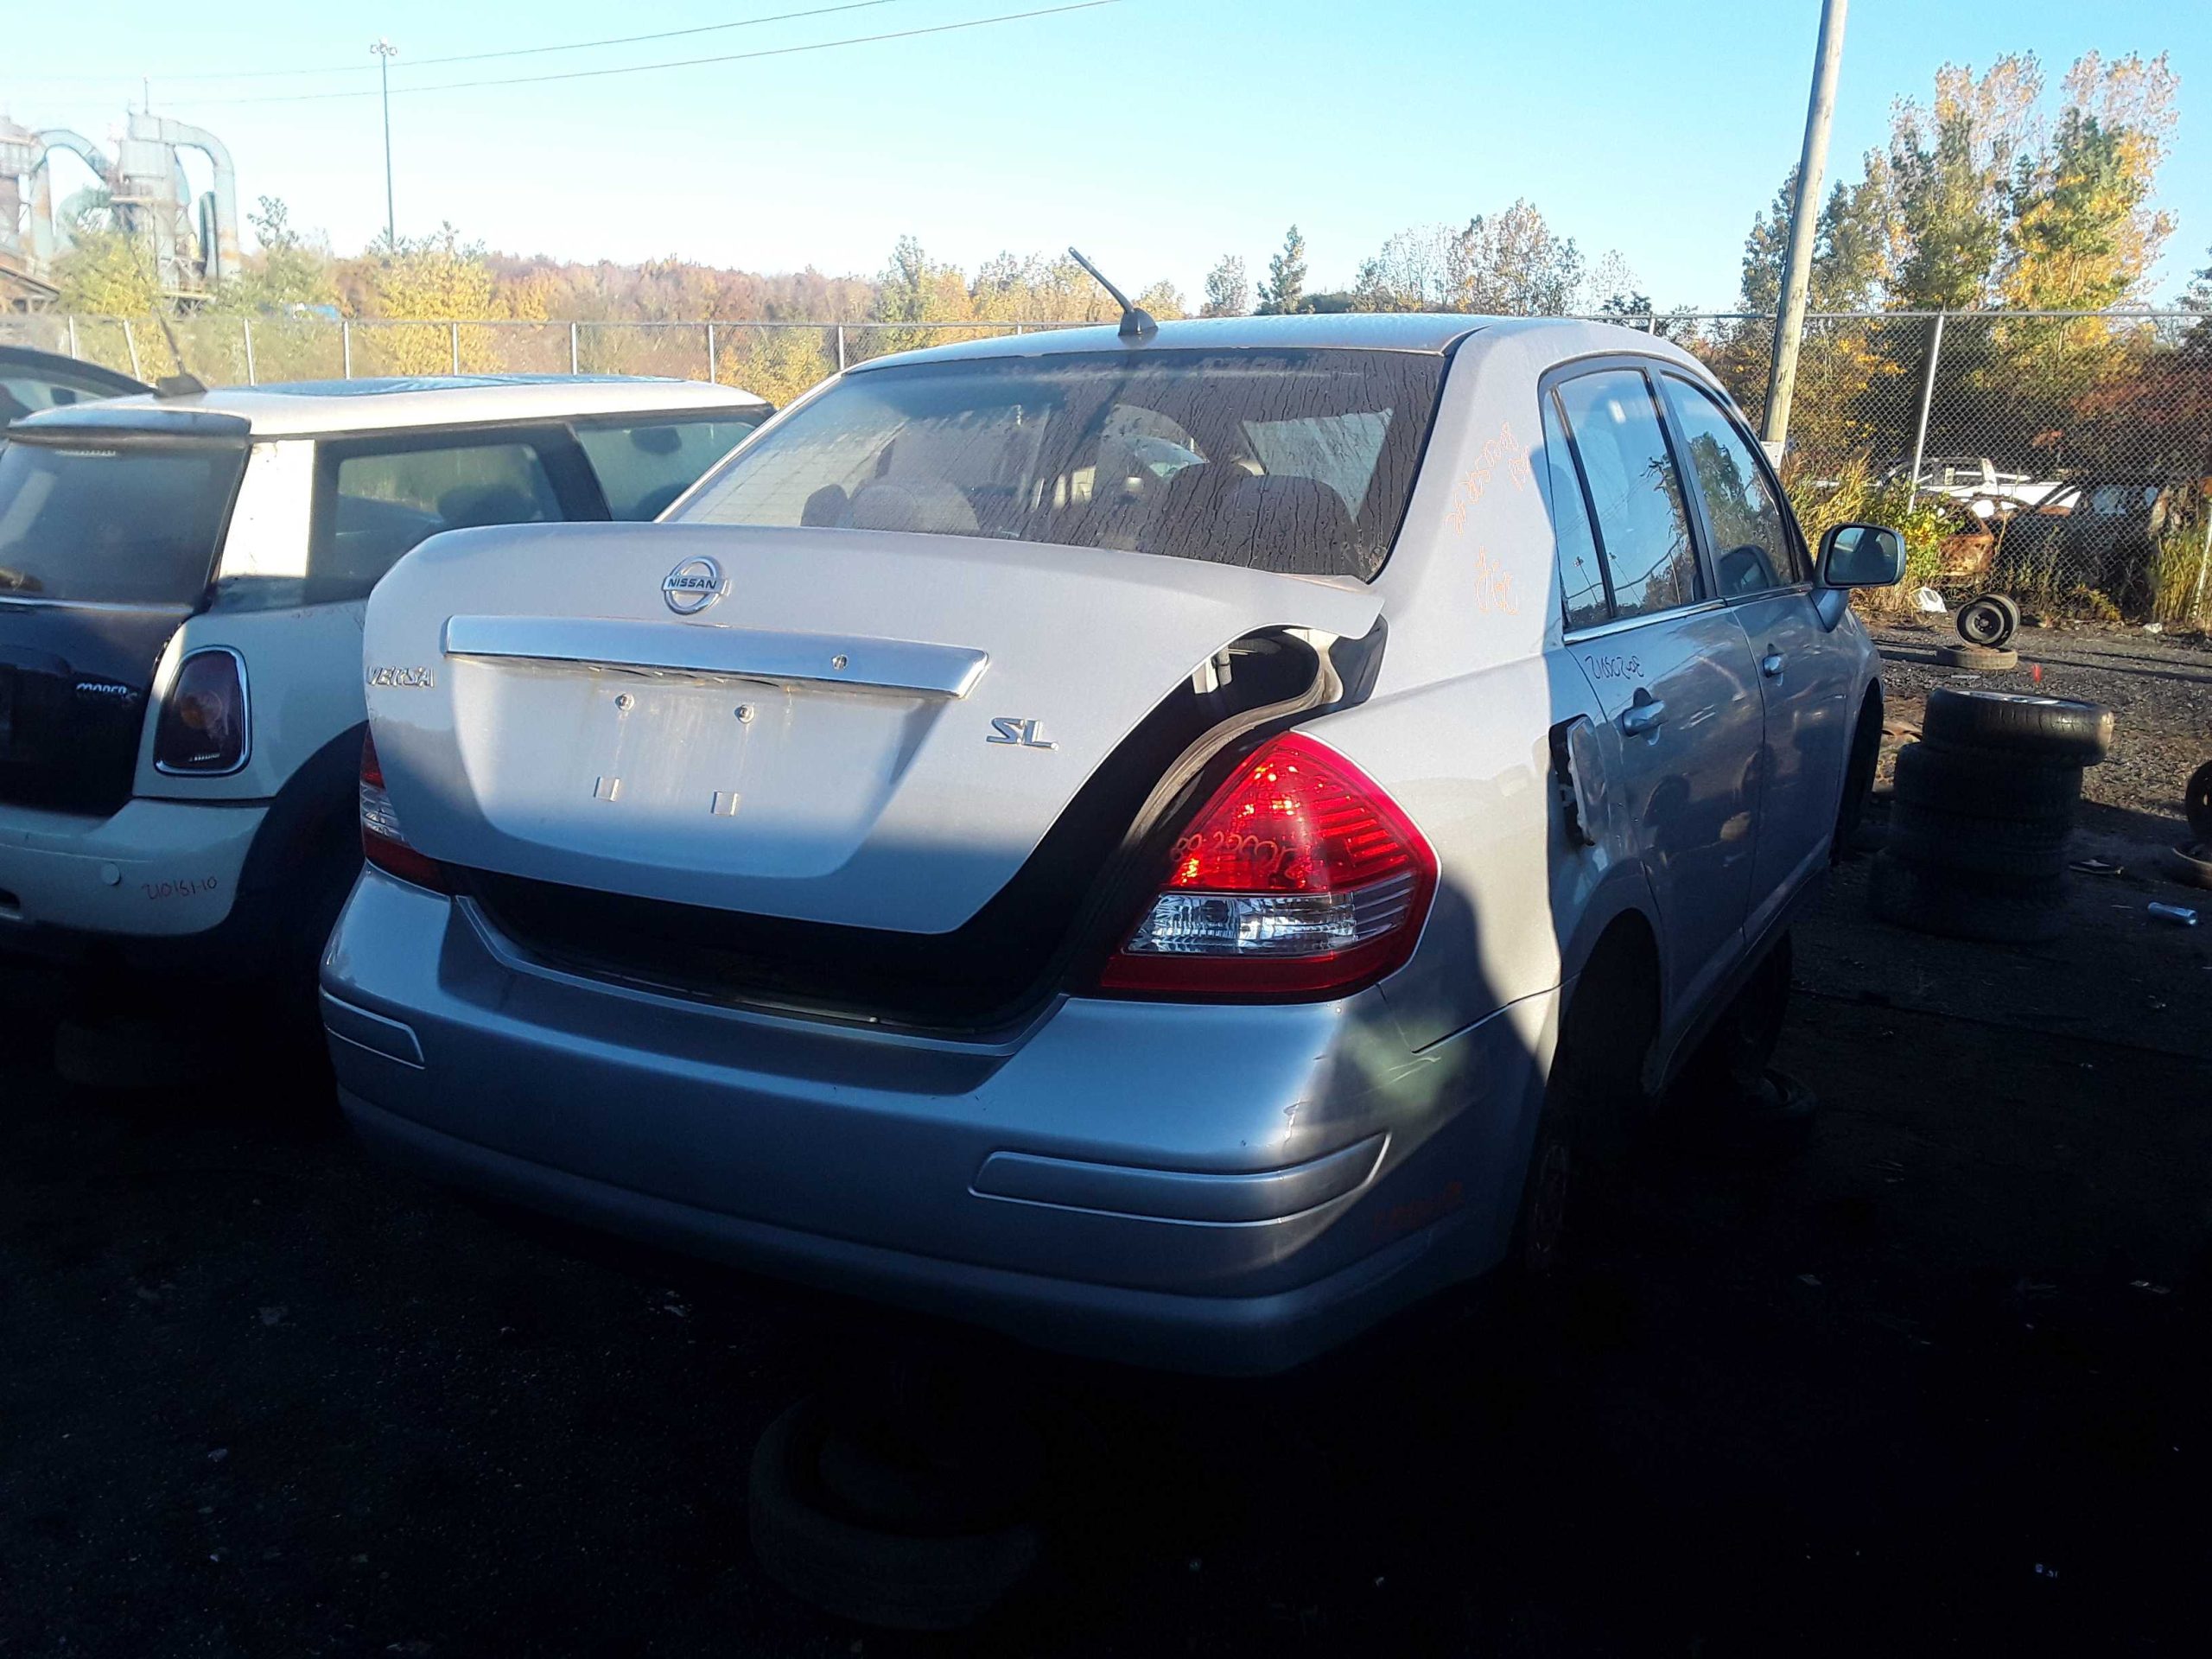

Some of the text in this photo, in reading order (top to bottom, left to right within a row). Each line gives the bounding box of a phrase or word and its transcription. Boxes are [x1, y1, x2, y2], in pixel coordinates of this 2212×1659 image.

[667, 577, 717, 590] NISSAN
[367, 664, 435, 688] VERSA
[986, 715, 1058, 750] SL
